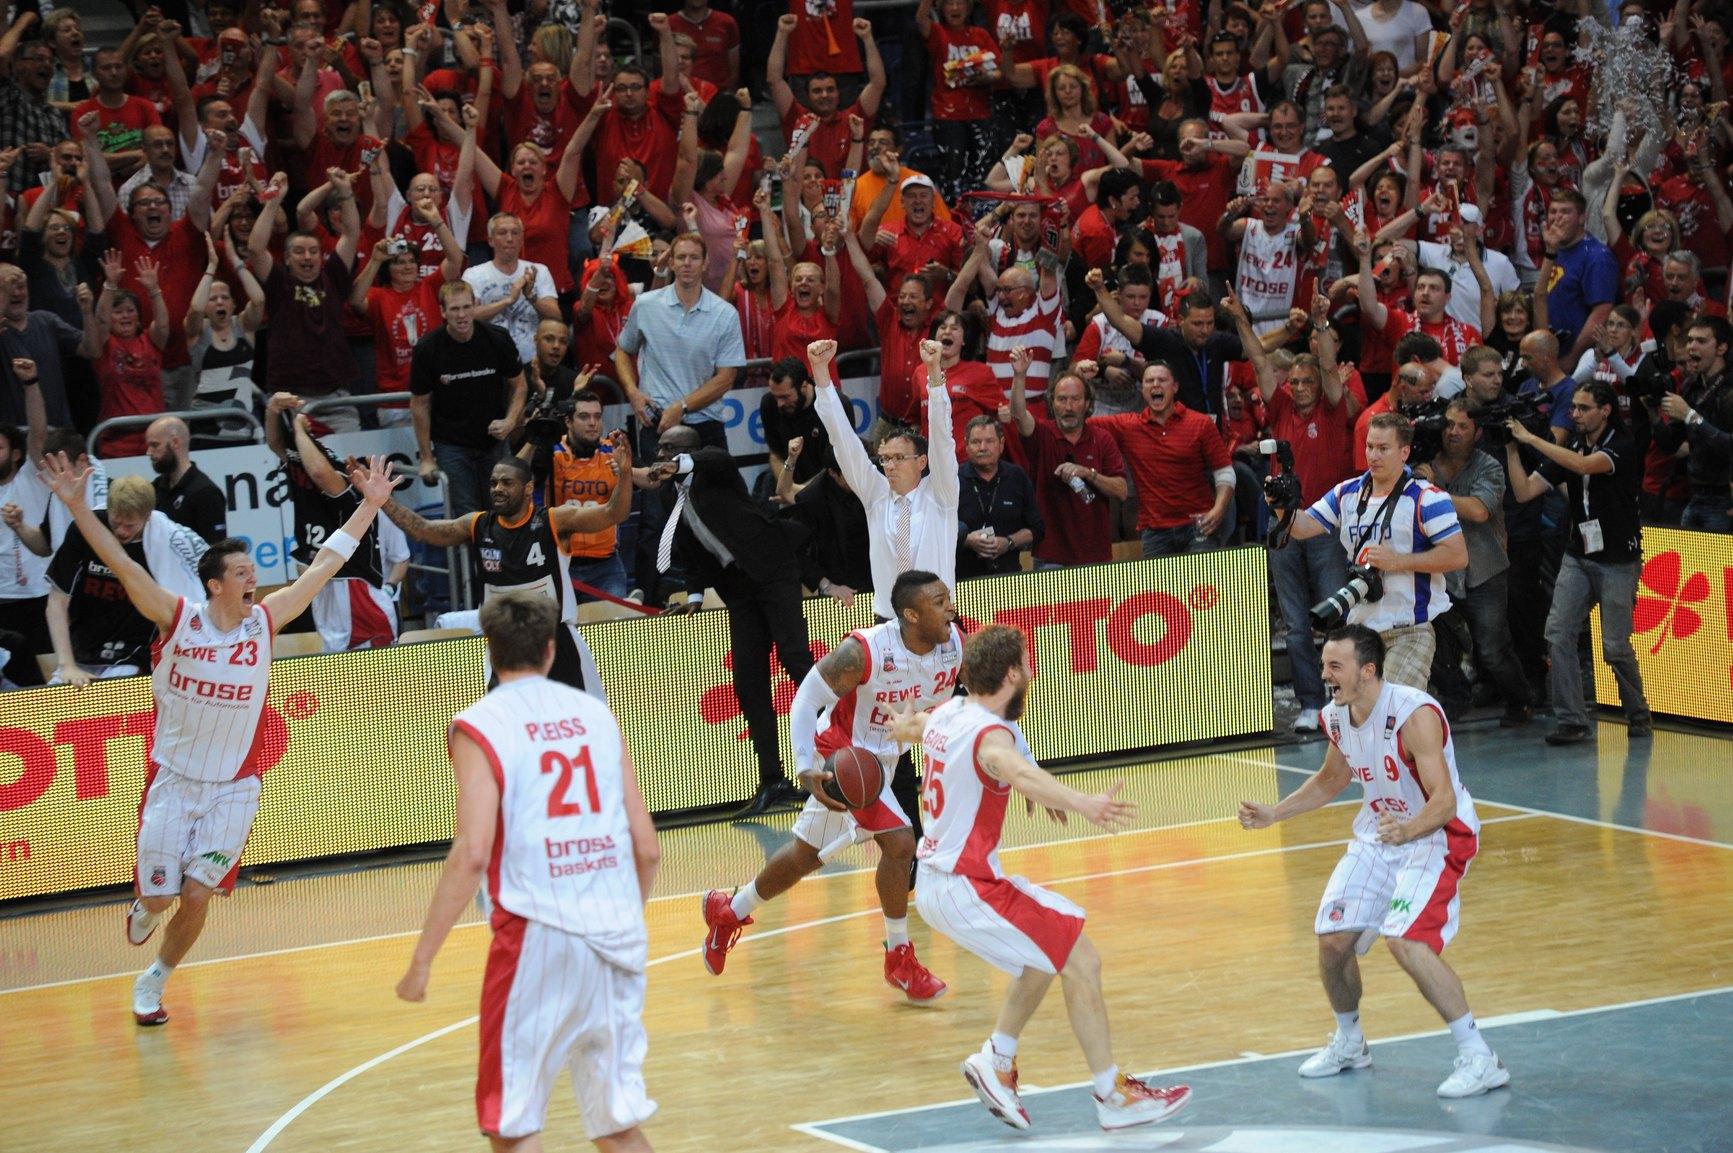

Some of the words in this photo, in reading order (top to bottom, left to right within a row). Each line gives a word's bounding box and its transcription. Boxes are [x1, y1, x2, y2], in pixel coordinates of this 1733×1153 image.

[1272, 251, 1293, 269] 24
[562, 480, 608, 497] FOTO
[526, 541, 546, 567] 4
[229, 640, 258, 667] 23
[169, 663, 254, 702] brose
[875, 685, 922, 704] REWE
[933, 667, 957, 695] 24
[1383, 754, 1400, 782] 9
[540, 744, 602, 820] 21
